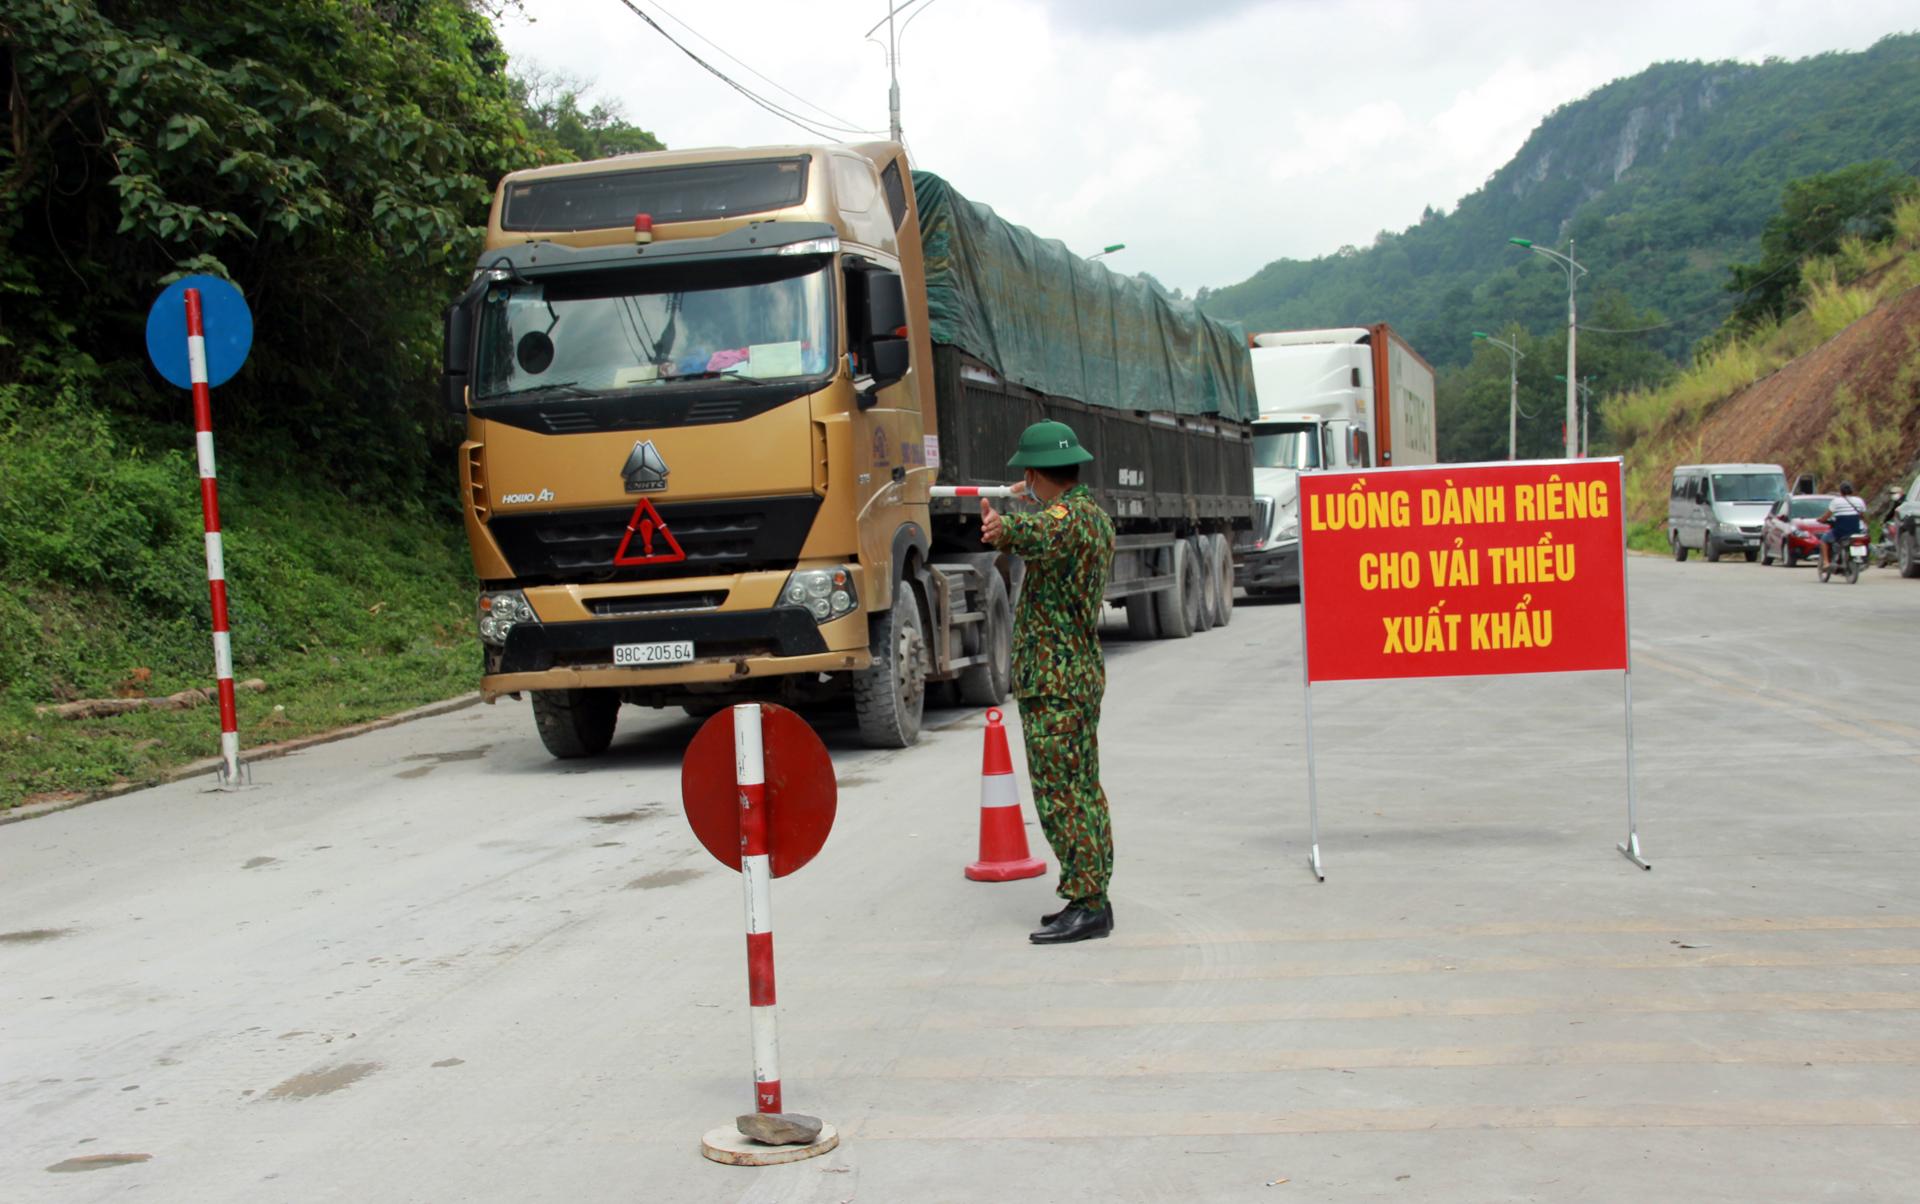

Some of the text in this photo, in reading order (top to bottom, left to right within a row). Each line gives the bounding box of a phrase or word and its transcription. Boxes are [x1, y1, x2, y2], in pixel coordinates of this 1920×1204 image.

[502, 488, 554, 504] HOWO A7
[1310, 474, 1609, 531] LUỒNG DÀNH RIÊNG
[1359, 532, 1576, 590] CHO VẢI THIỀU
[1382, 593, 1552, 655] XUẤT KHẨU
